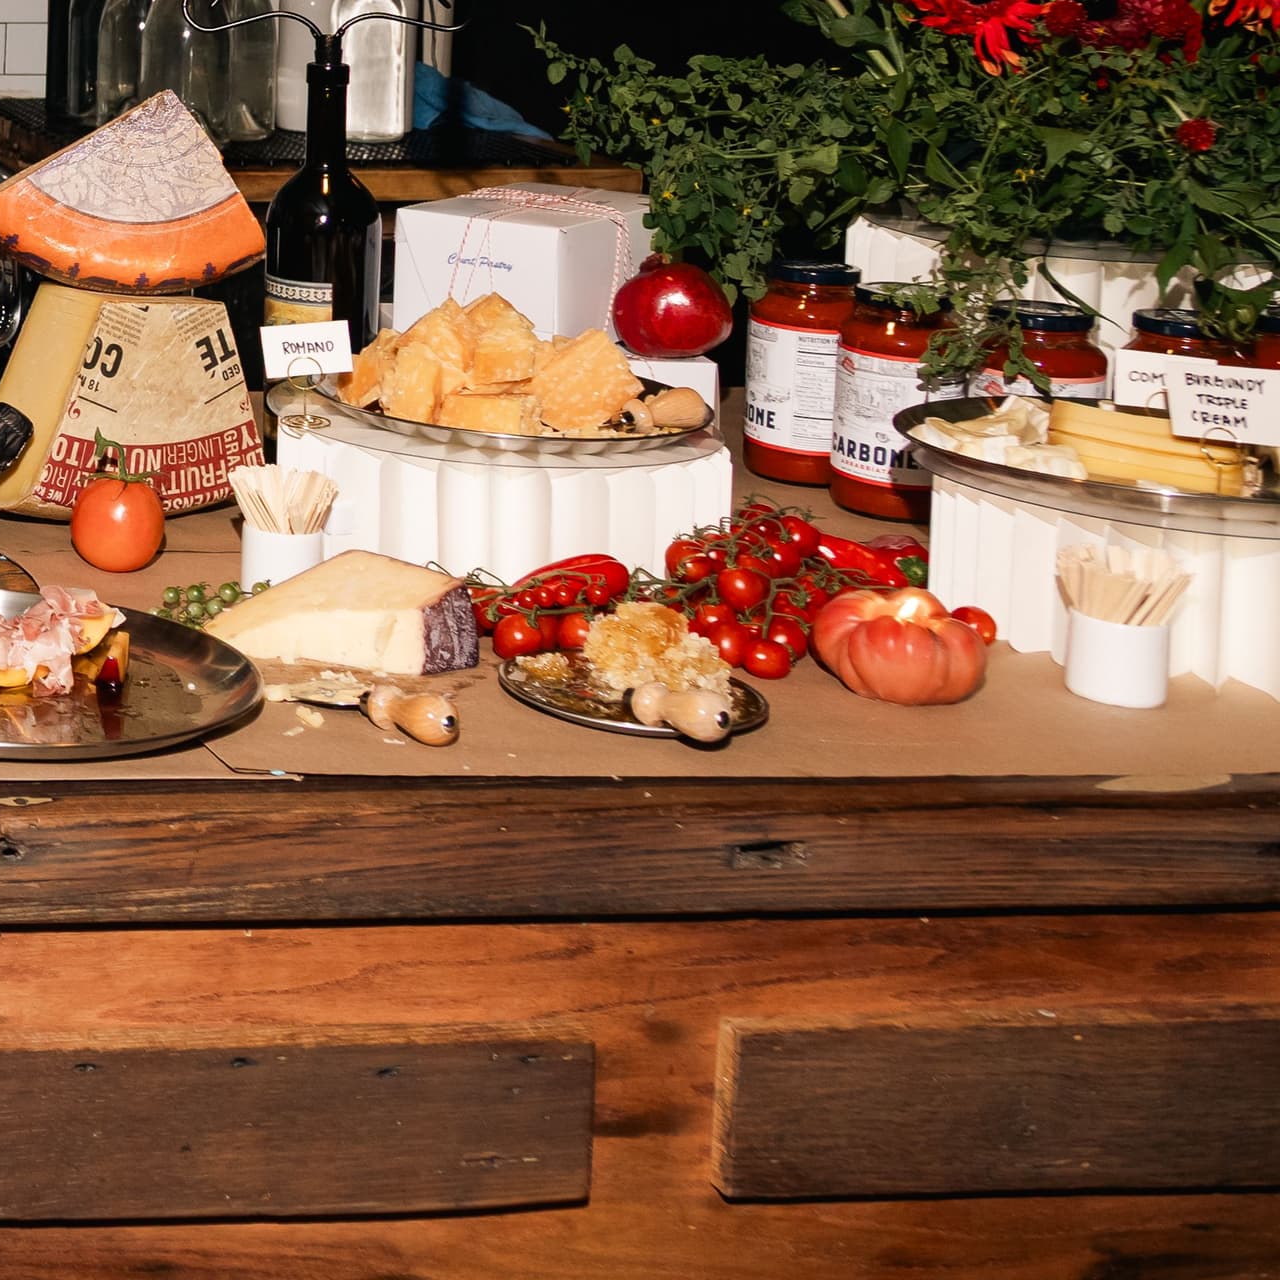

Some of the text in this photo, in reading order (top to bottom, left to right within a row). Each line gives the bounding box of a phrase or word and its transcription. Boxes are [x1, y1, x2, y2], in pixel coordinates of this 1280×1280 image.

[479, 256, 513, 272] Pastry
[282, 340, 334, 354] ROMANO
[1129, 370, 1166, 387] COM
[1184, 372, 1265, 395] BURGUNDY
[1196, 393, 1248, 410] TRIPLE
[1191, 410, 1248, 429] CREAM
